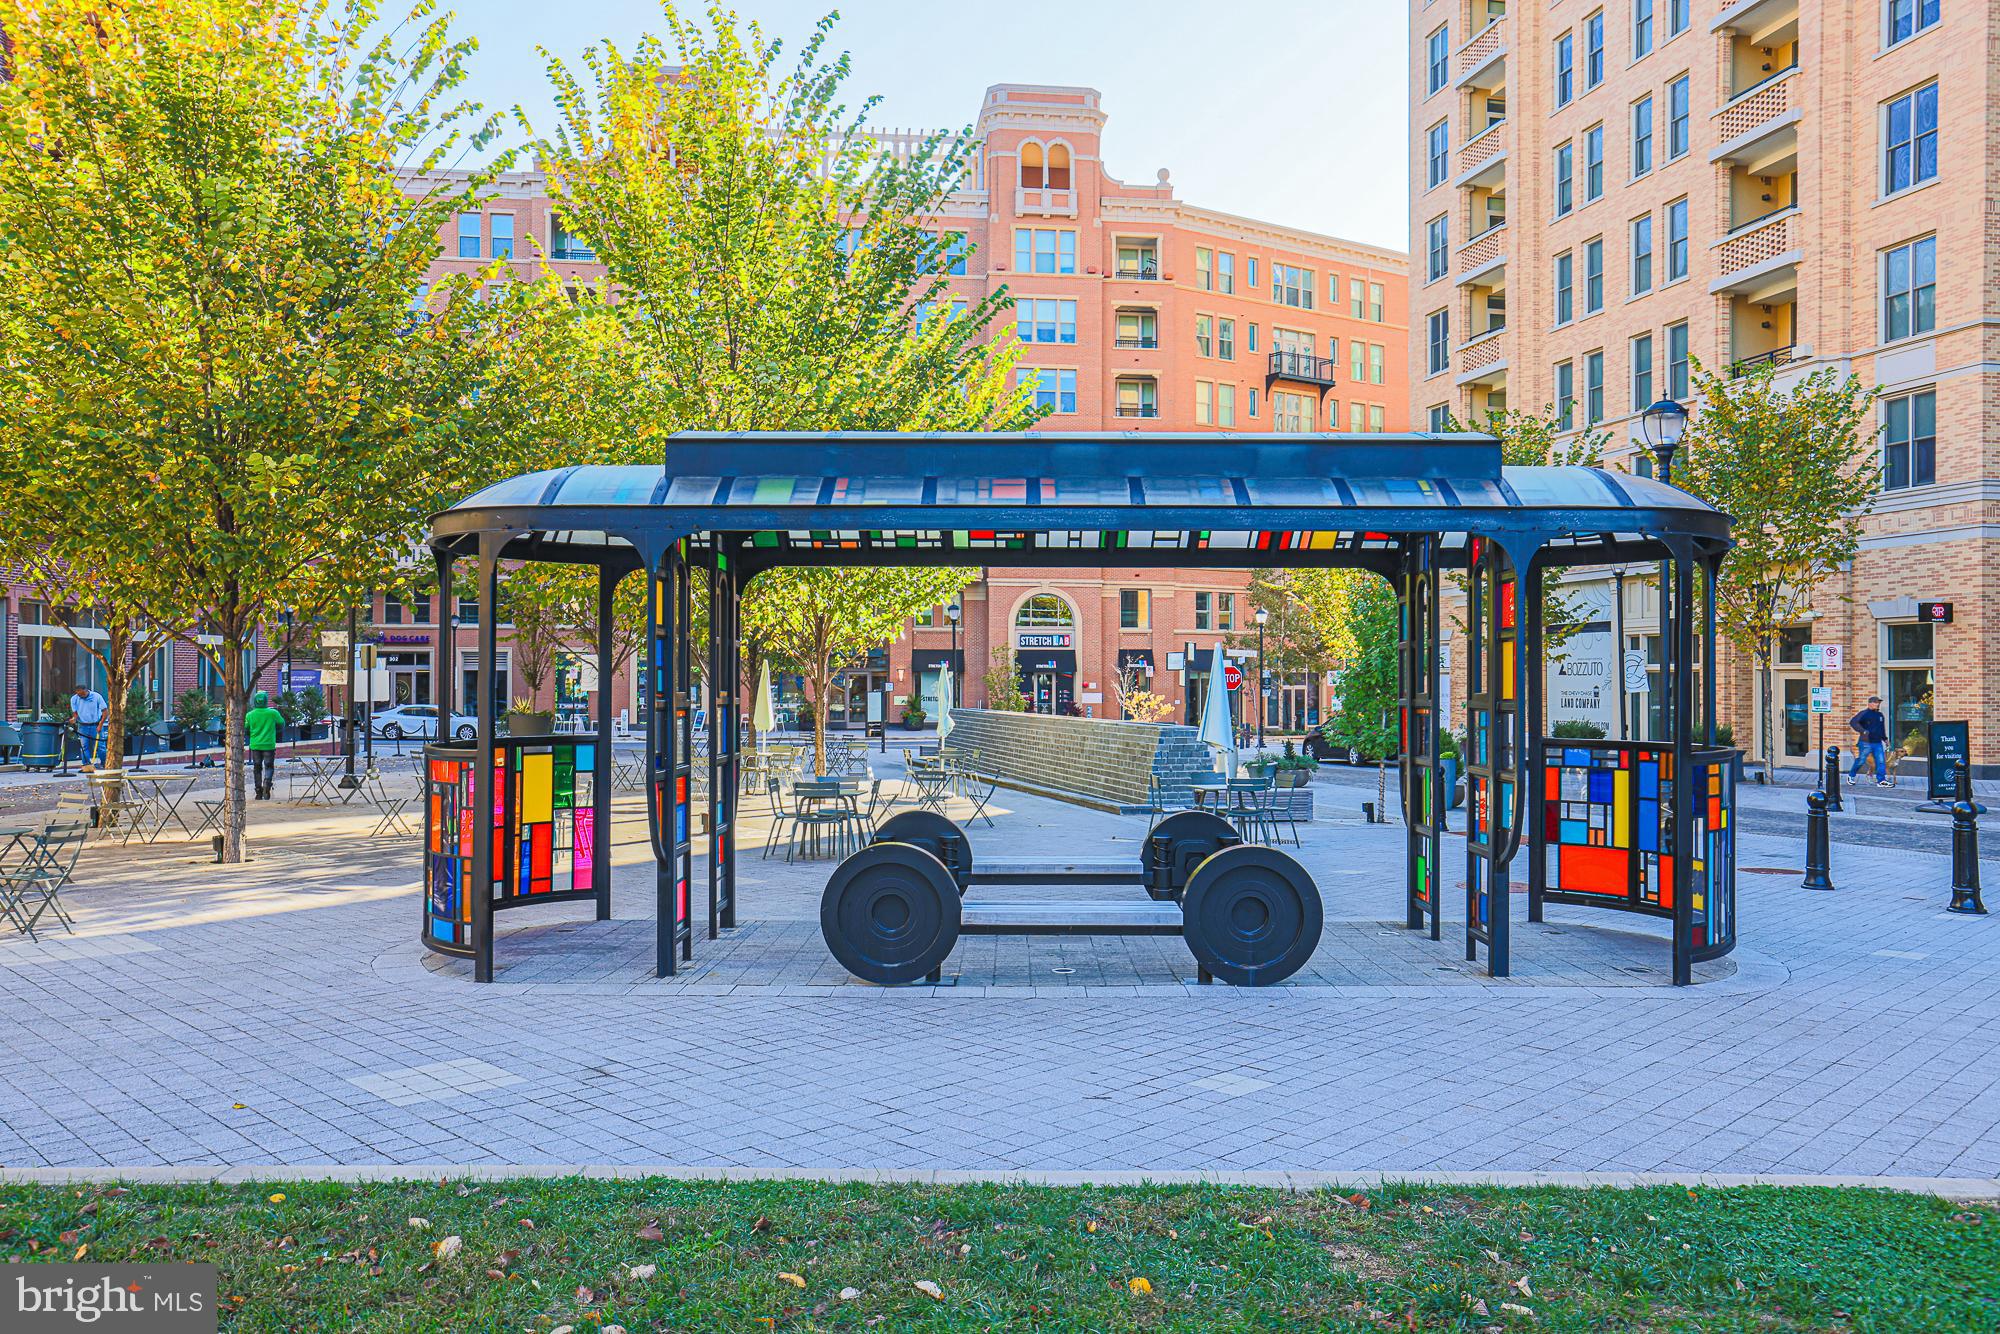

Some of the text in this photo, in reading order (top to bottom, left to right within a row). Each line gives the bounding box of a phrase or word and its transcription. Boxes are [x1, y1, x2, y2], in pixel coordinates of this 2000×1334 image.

[409, 635, 431, 643] CARE
[1020, 636, 1052, 646] STRETCH
[1566, 662, 1603, 676] BOZZUTO
[1225, 673, 1241, 683] TOP
[1561, 698, 1601, 709] LAND COMPANY
